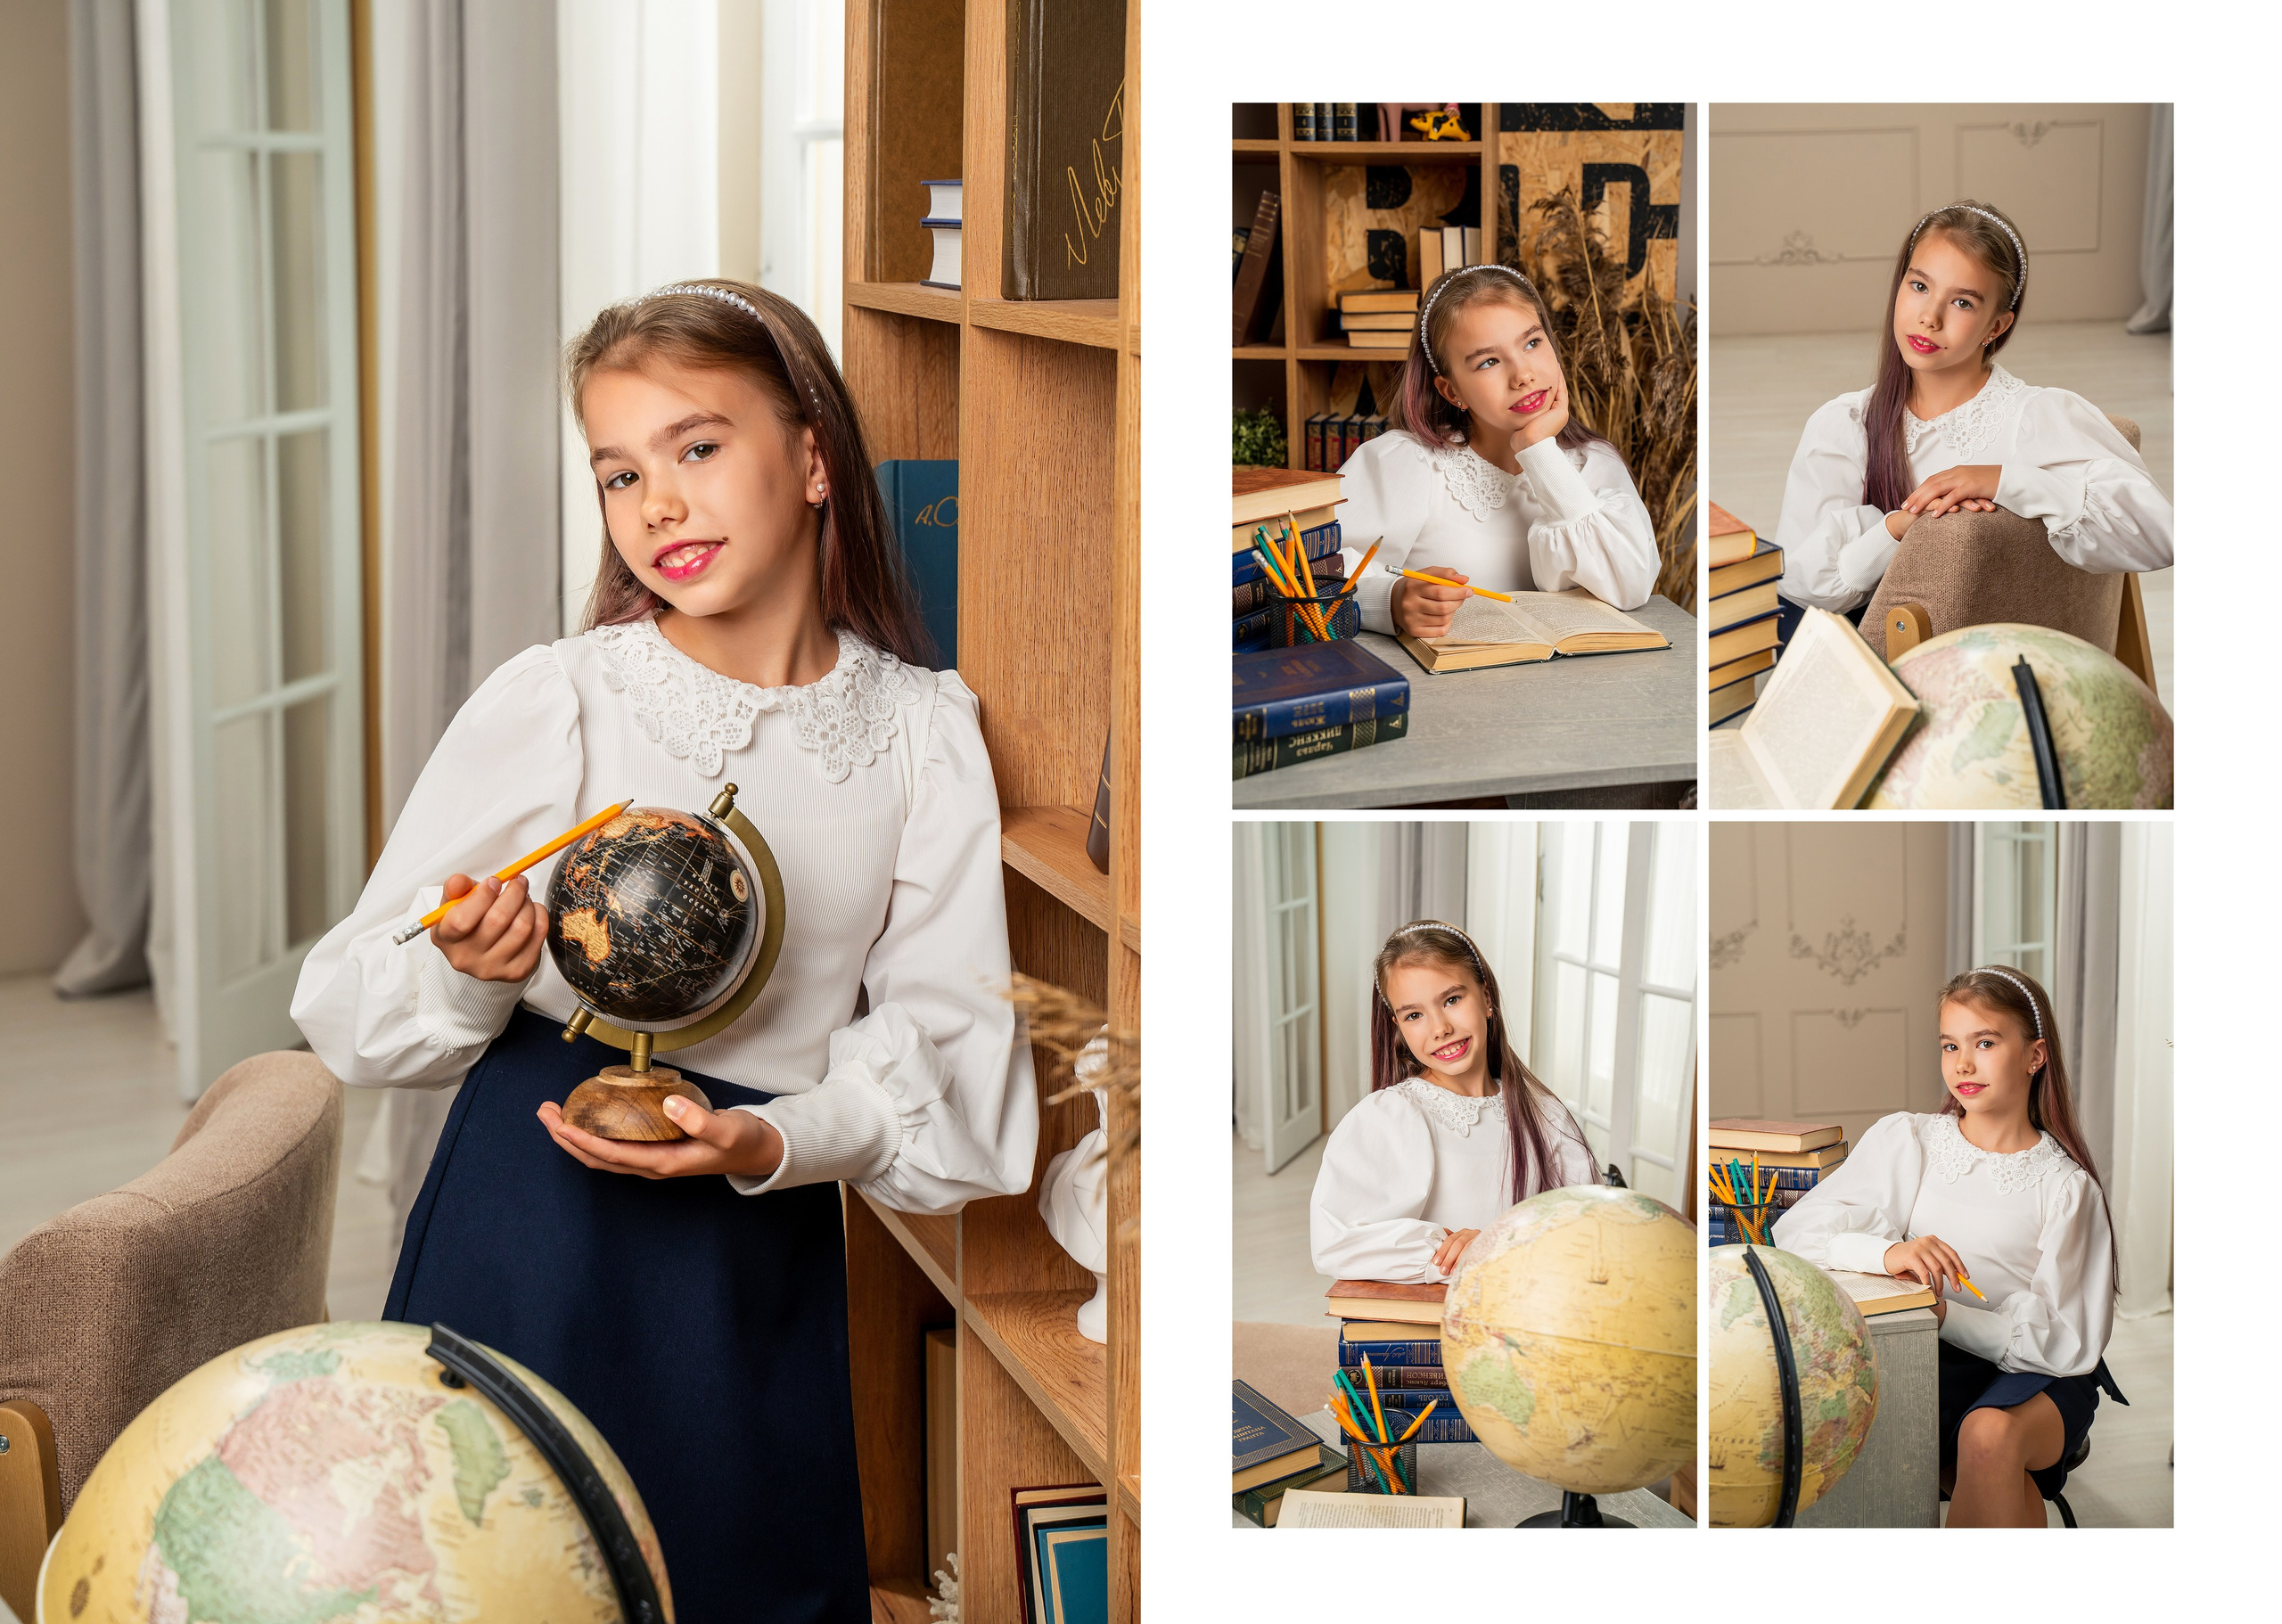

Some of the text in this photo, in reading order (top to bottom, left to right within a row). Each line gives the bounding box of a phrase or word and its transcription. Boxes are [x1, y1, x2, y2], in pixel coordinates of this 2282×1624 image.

[1287, 725, 1342, 748] ДИККЕНС
[1295, 741, 1334, 758] Чарльз
[1232, 1425, 1266, 1439] АПИТАНА
